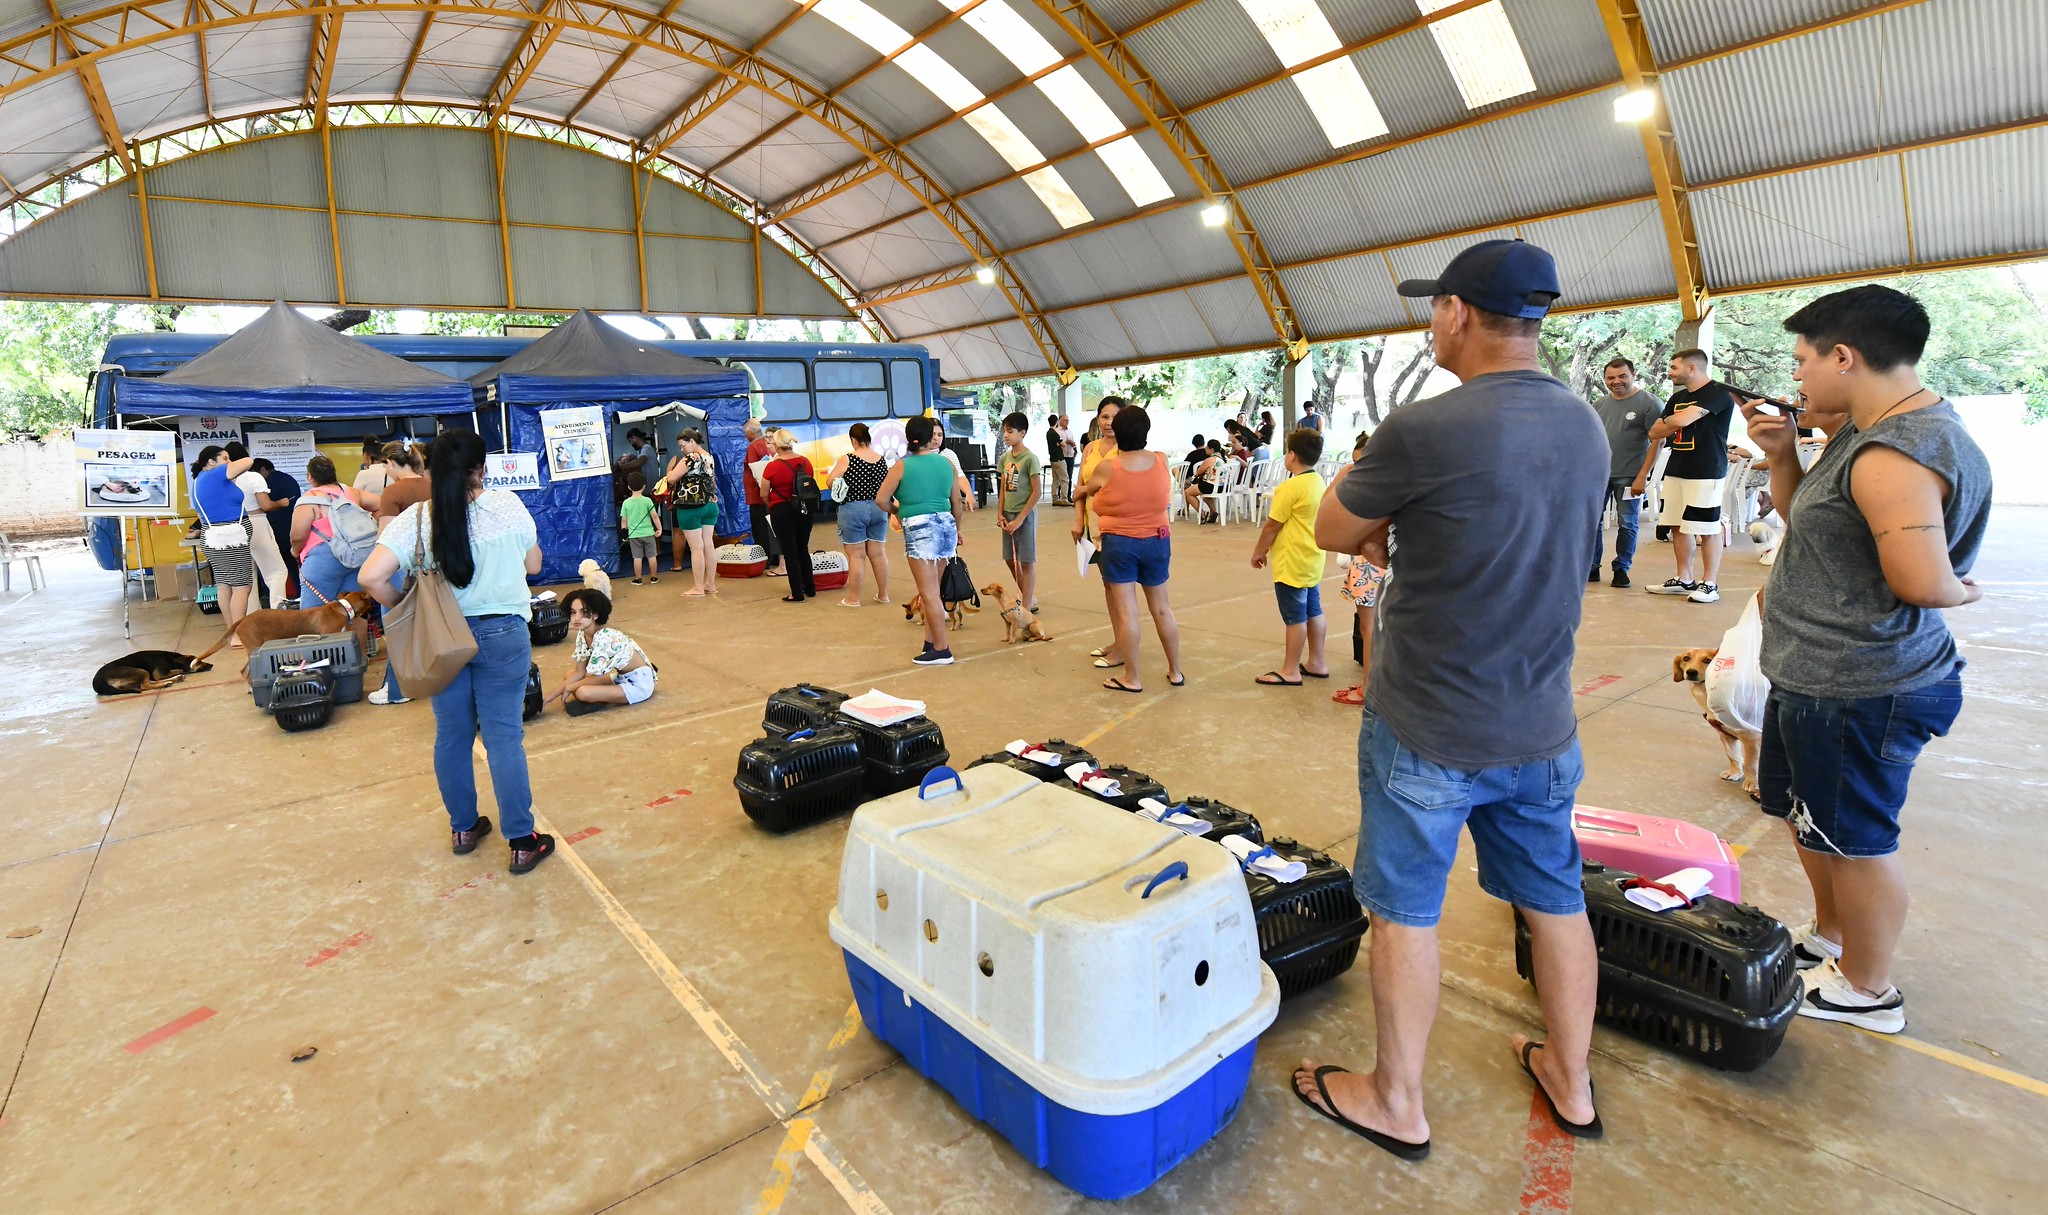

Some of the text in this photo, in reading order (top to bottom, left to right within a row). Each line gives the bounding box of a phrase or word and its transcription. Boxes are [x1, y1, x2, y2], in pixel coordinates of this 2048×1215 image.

[553, 421, 594, 429] ATENDIMENTO
[182, 428, 239, 440] PARANÁ
[97, 450, 156, 460] PESAGEM
[483, 473, 537, 487] PARANÁ
